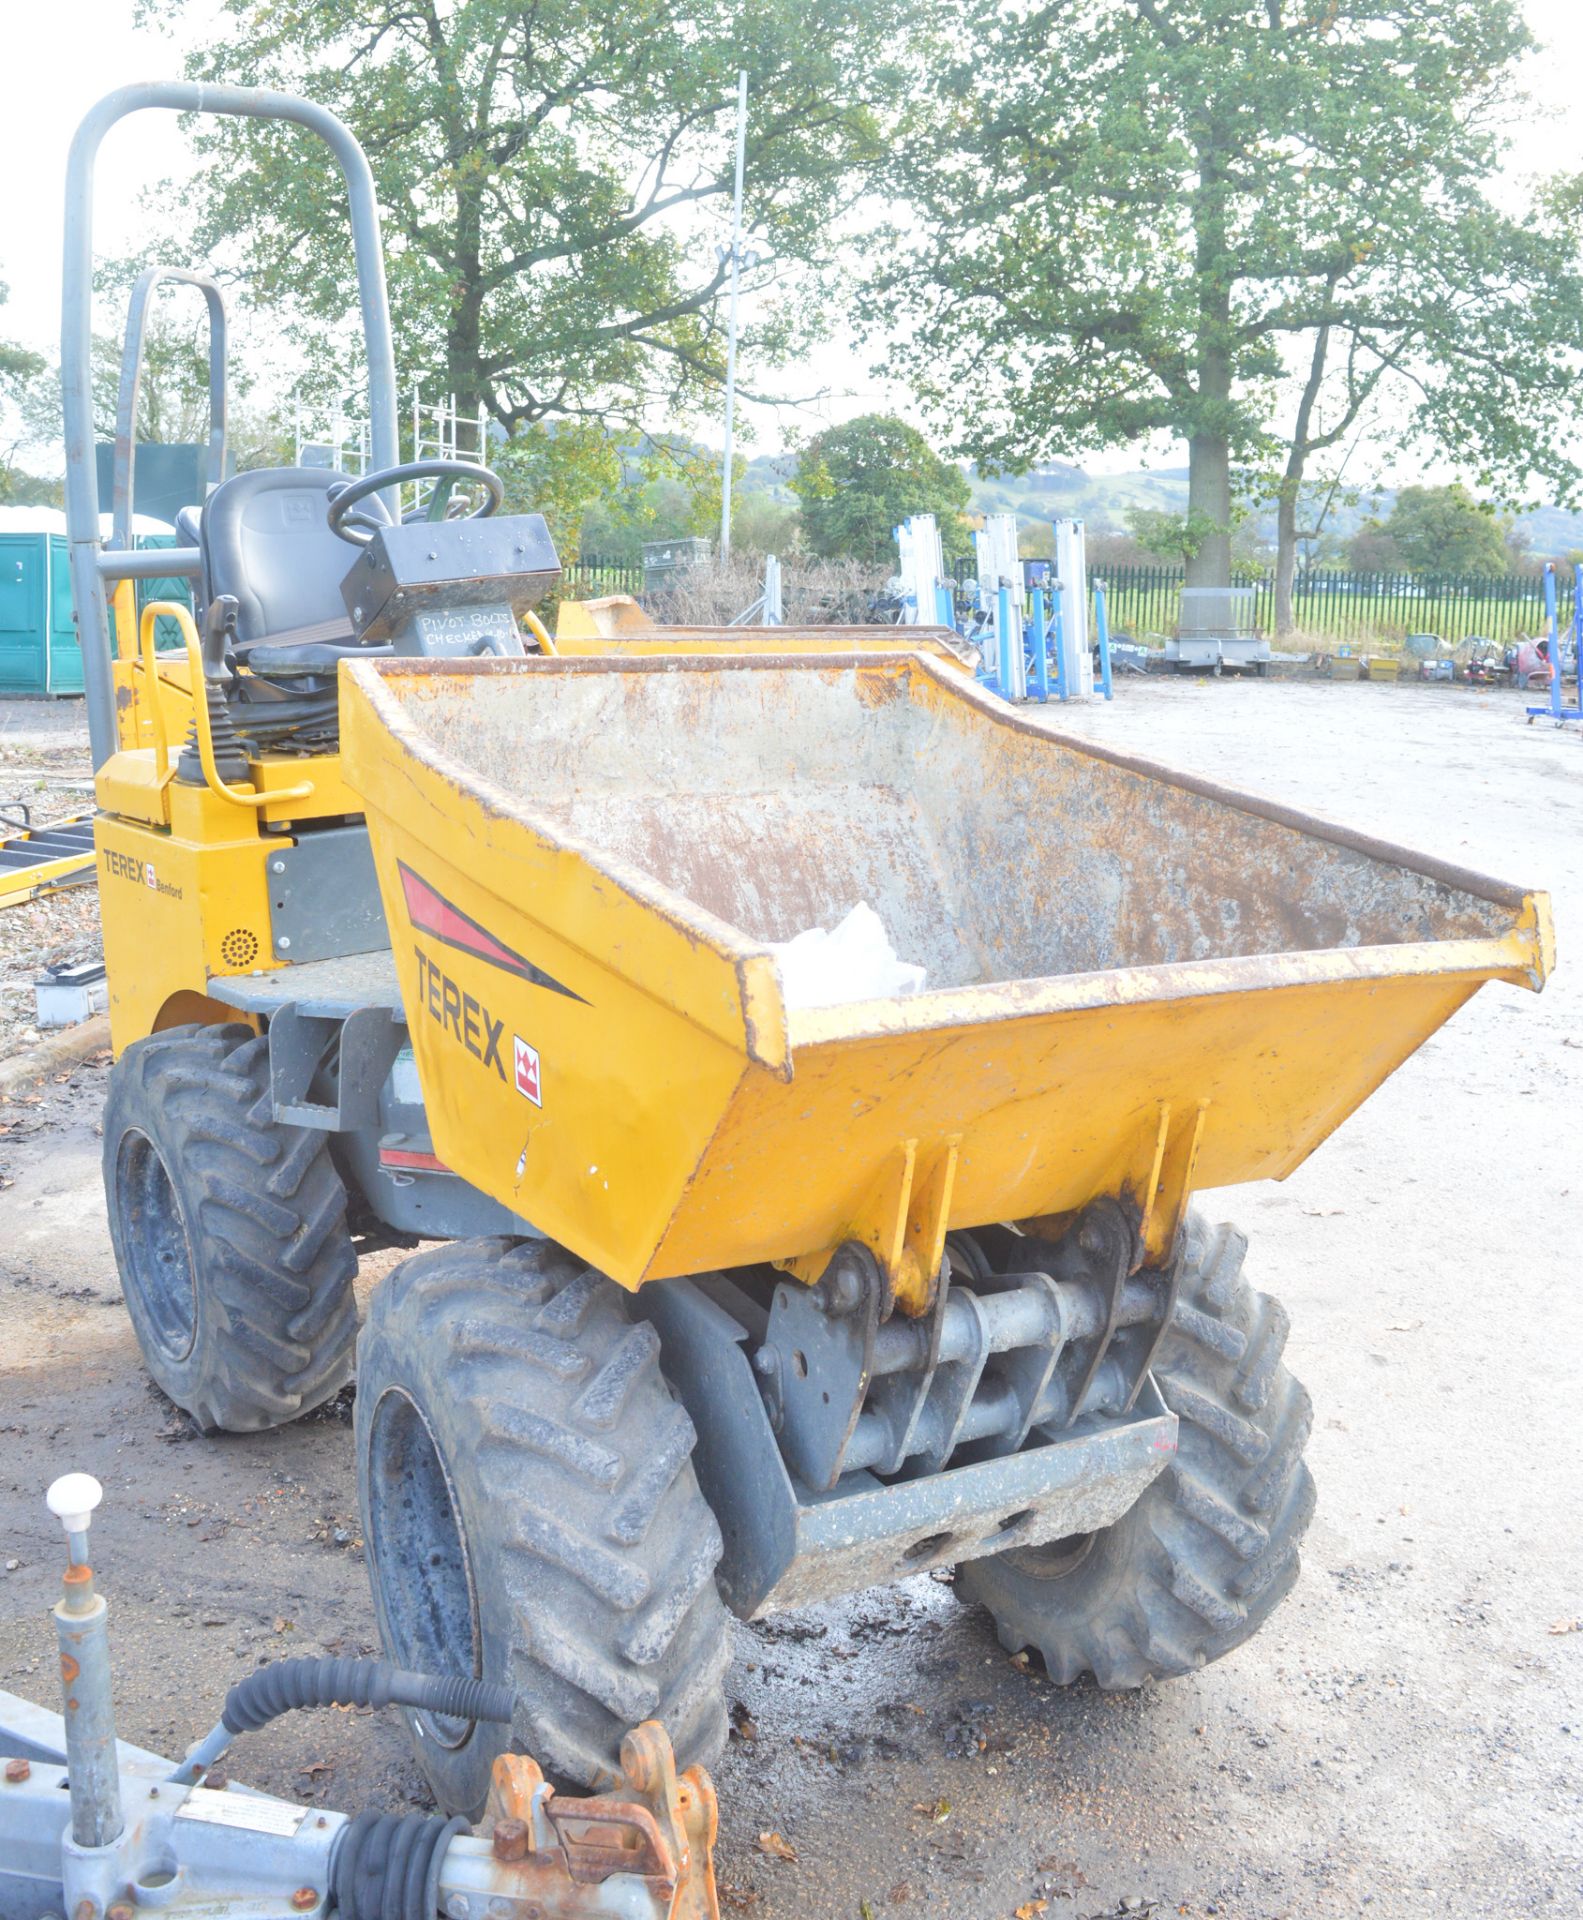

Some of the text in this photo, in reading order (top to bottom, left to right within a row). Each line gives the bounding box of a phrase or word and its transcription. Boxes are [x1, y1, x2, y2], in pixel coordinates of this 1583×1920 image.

[421, 613, 510, 631] PIVOT BOLTS
[103, 848, 146, 885] TEREX
[414, 944, 508, 1083] TEREX
